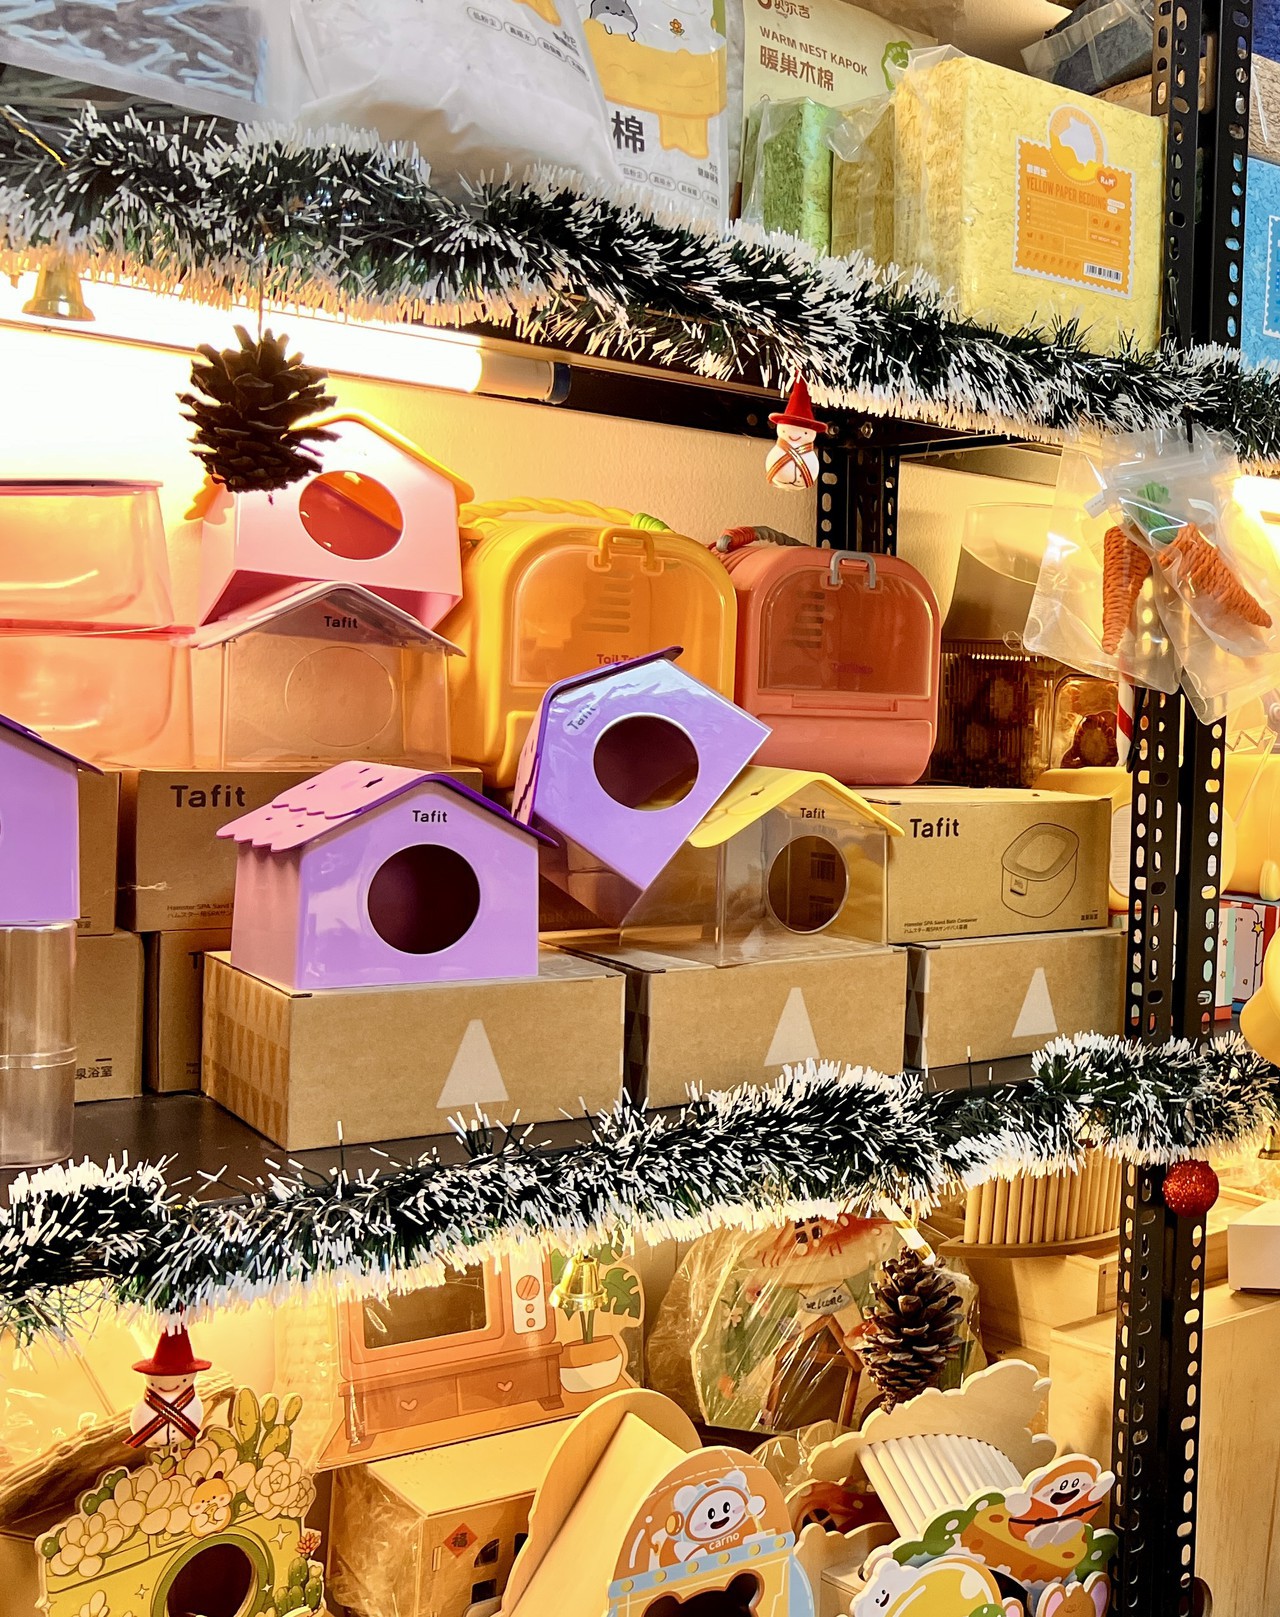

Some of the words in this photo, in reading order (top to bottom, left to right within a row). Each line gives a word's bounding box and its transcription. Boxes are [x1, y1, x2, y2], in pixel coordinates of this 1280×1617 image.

[759, 25, 798, 50] WARM
[799, 42, 828, 61] NEST
[830, 52, 868, 76] KAPOK
[760, 45, 834, 92] 暖巢木棉
[611, 110, 645, 154] 棉
[1026, 176, 1054, 196] YELLOW
[1055, 183, 1078, 203] PAPER
[1079, 190, 1107, 211] BEDDING
[323, 615, 358, 629] Tafit
[170, 784, 246, 808] Tafit
[412, 809, 448, 823] Tafit
[800, 807, 826, 819] Tafit
[909, 817, 960, 838] Tafit
[805, 1294, 843, 1310] welcome
[708, 1532, 740, 1551] carno
